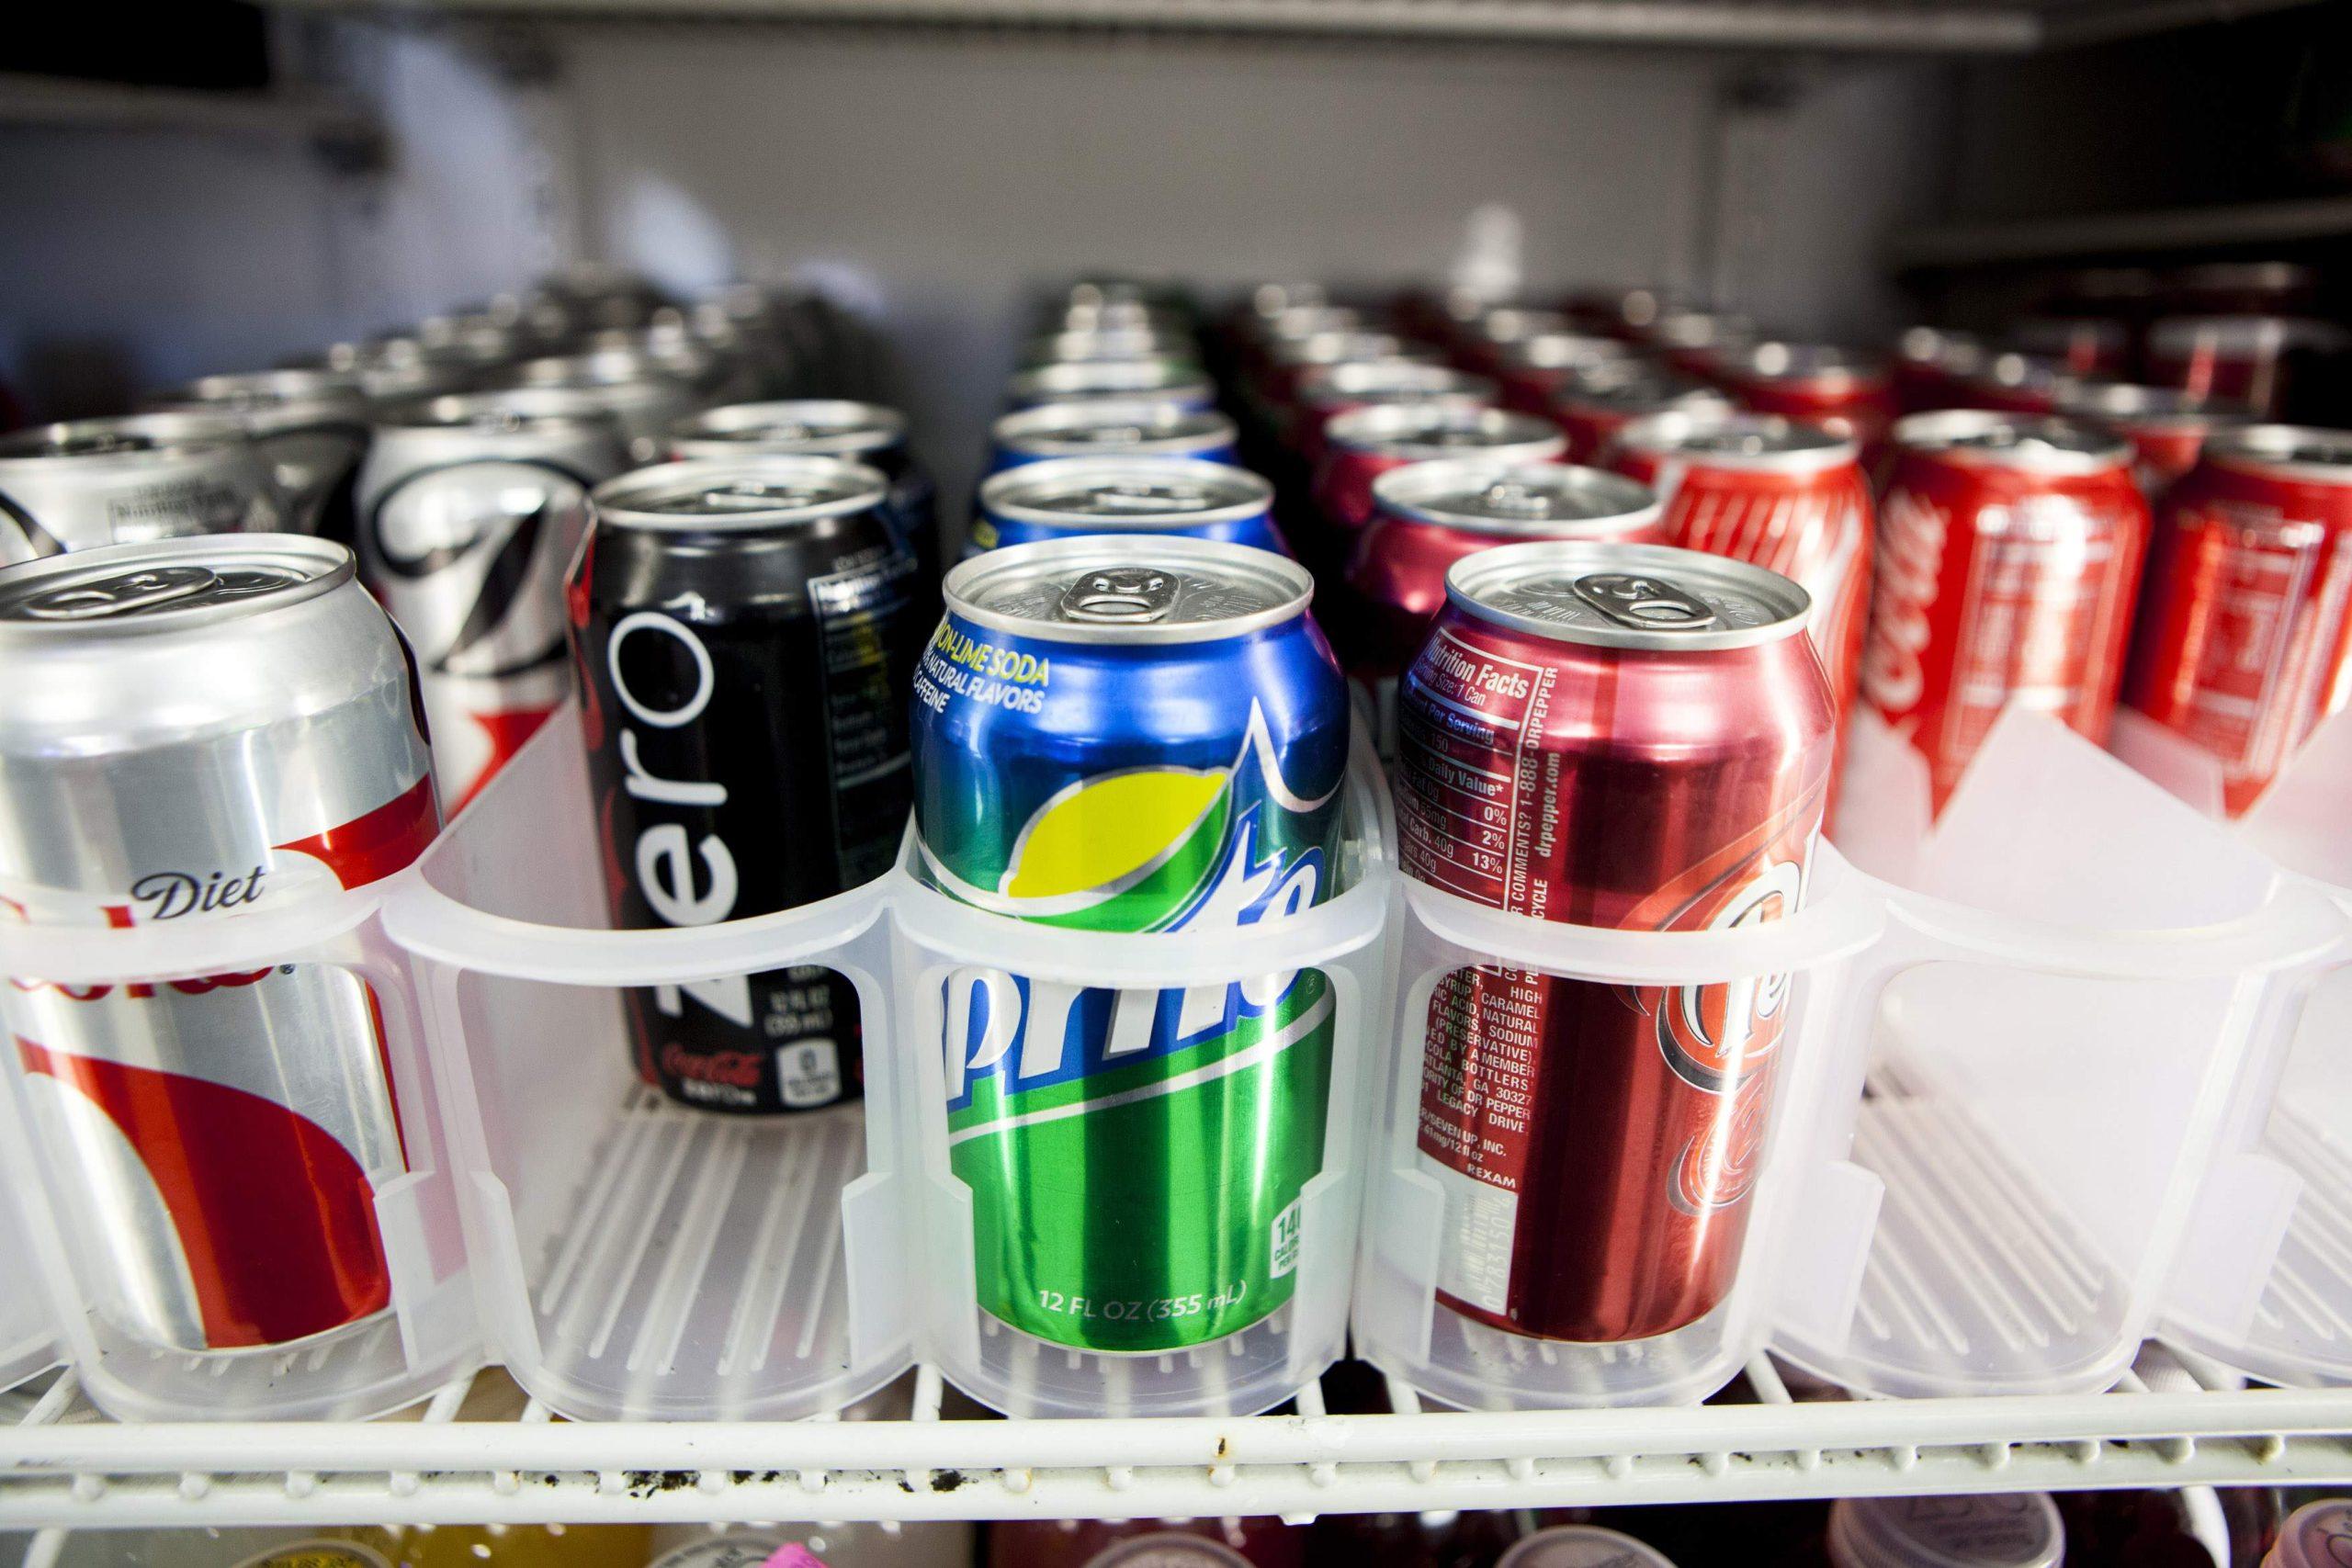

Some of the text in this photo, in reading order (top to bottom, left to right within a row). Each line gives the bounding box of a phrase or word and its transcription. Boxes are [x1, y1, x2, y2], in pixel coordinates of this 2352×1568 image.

[927, 653, 969, 694] NATURAL
[966, 676, 1046, 715] FLAVORS
[986, 649, 1050, 687] SODA
[1426, 636, 1476, 682] Nutrition
[1475, 663, 1530, 699] Facts
[914, 670, 951, 714] CAFFEINE
[1435, 672, 1456, 695] Size:
[1456, 683, 1465, 697] 1
[1464, 685, 1487, 706] Can
[1429, 703, 1446, 722] Per
[1447, 712, 1495, 746] Serving
[1520, 666, 1559, 807] 1-888-DRPEPPER
[1428, 757, 1456, 780] Daily
[1484, 806, 1508, 827] 0%
[1533, 751, 1561, 858] drpepper.com
[1409, 817, 1432, 844] Carb.
[1434, 835, 1454, 859] 40g
[1482, 830, 1505, 850] 2%
[1510, 811, 1533, 902] COMMENTS?
[1419, 850, 1438, 874] 40g
[1472, 851, 1503, 874] 13%
[131, 865, 269, 919] Diet
[1530, 877, 1549, 919] CYCLE
[1481, 992, 1542, 1020] CARAMEL
[1510, 986, 1543, 1005] HIGH
[1432, 999, 1539, 1049] FLAVORS, SODIUM
[1452, 996, 1539, 1034] ACID, NATURAL
[1450, 1038, 1536, 1078] BY A MEMBER
[1437, 1091, 1479, 1118] LEGACY
[1451, 1082, 1464, 1097] OF
[1466, 1089, 1483, 1106] DR
[1485, 1098, 1532, 1121] PEPPER
[1473, 1077, 1490, 1094] GA
[1496, 1086, 1533, 1107] 30327
[1482, 1138, 1508, 1157] INC.
[1466, 1163, 1516, 1189] REXAM
[1039, 1279, 1248, 1323] 12 FL OZ (355 mL)
